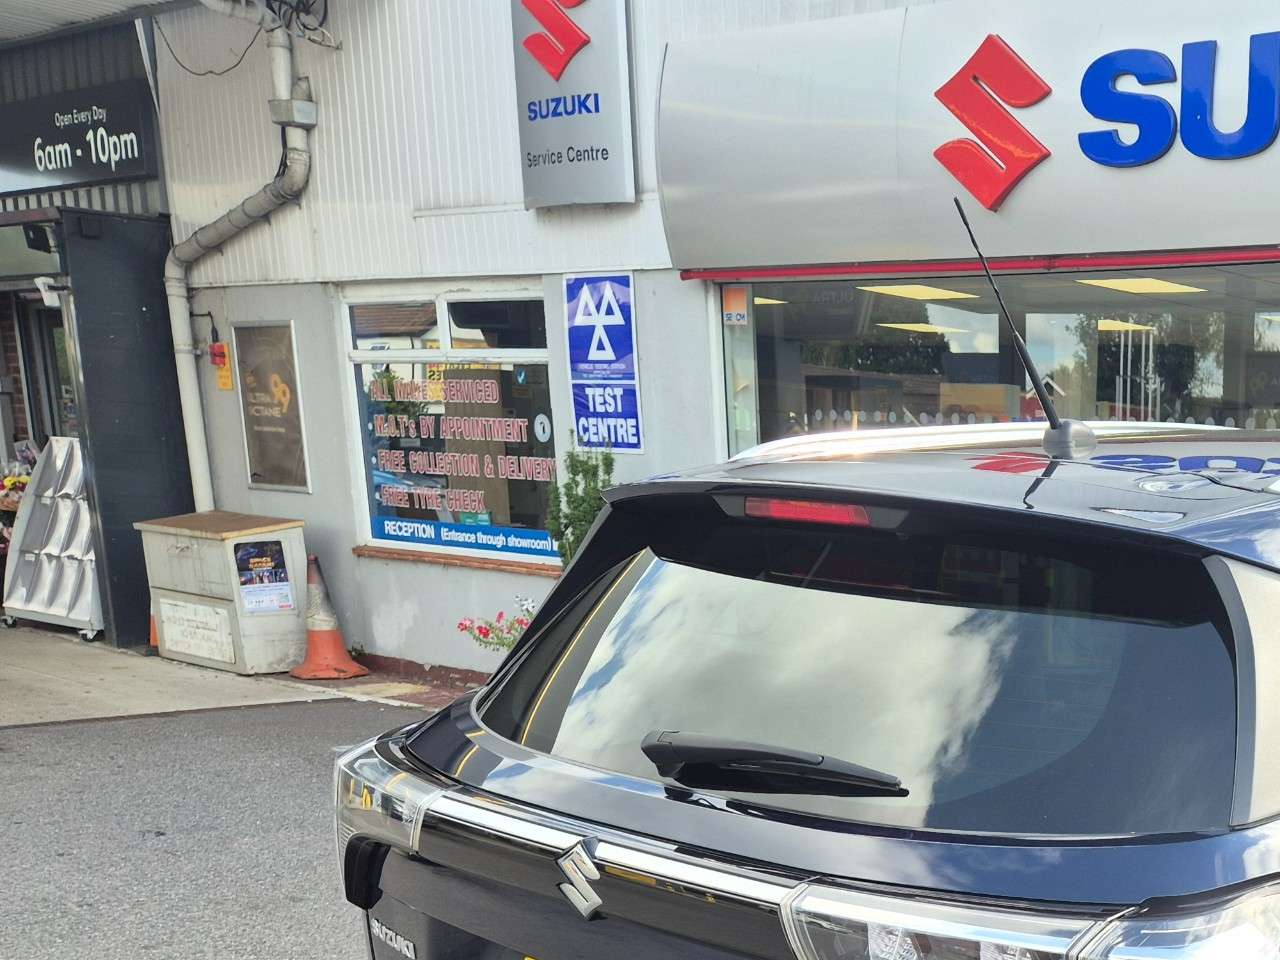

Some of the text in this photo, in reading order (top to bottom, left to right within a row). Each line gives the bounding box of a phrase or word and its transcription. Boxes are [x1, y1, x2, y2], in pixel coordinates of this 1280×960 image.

[55, 105, 106, 129] Open Every Day
[528, 93, 600, 121] SUZUKI
[34, 137, 72, 172] 6am
[85, 126, 138, 172] 10pm
[527, 146, 609, 168] Service Centre
[371, 379, 392, 401] ALL
[442, 379, 500, 404] SERVICED
[585, 387, 624, 413] TEST
[419, 416, 436, 438] BY
[440, 416, 528, 442] APPOINTMENT
[578, 417, 638, 444] CENTRE
[377, 450, 556, 481] FREE COLLECTION & DELIVERY
[381, 484, 486, 512] FREE TYRE CHECK
[384, 520, 435, 539] RECEPTION
[441, 527, 476, 543] (Entrance
[476, 532, 506, 549] through
[507, 535, 552, 551] showroom)
[370, 918, 416, 960] SUZUKI
